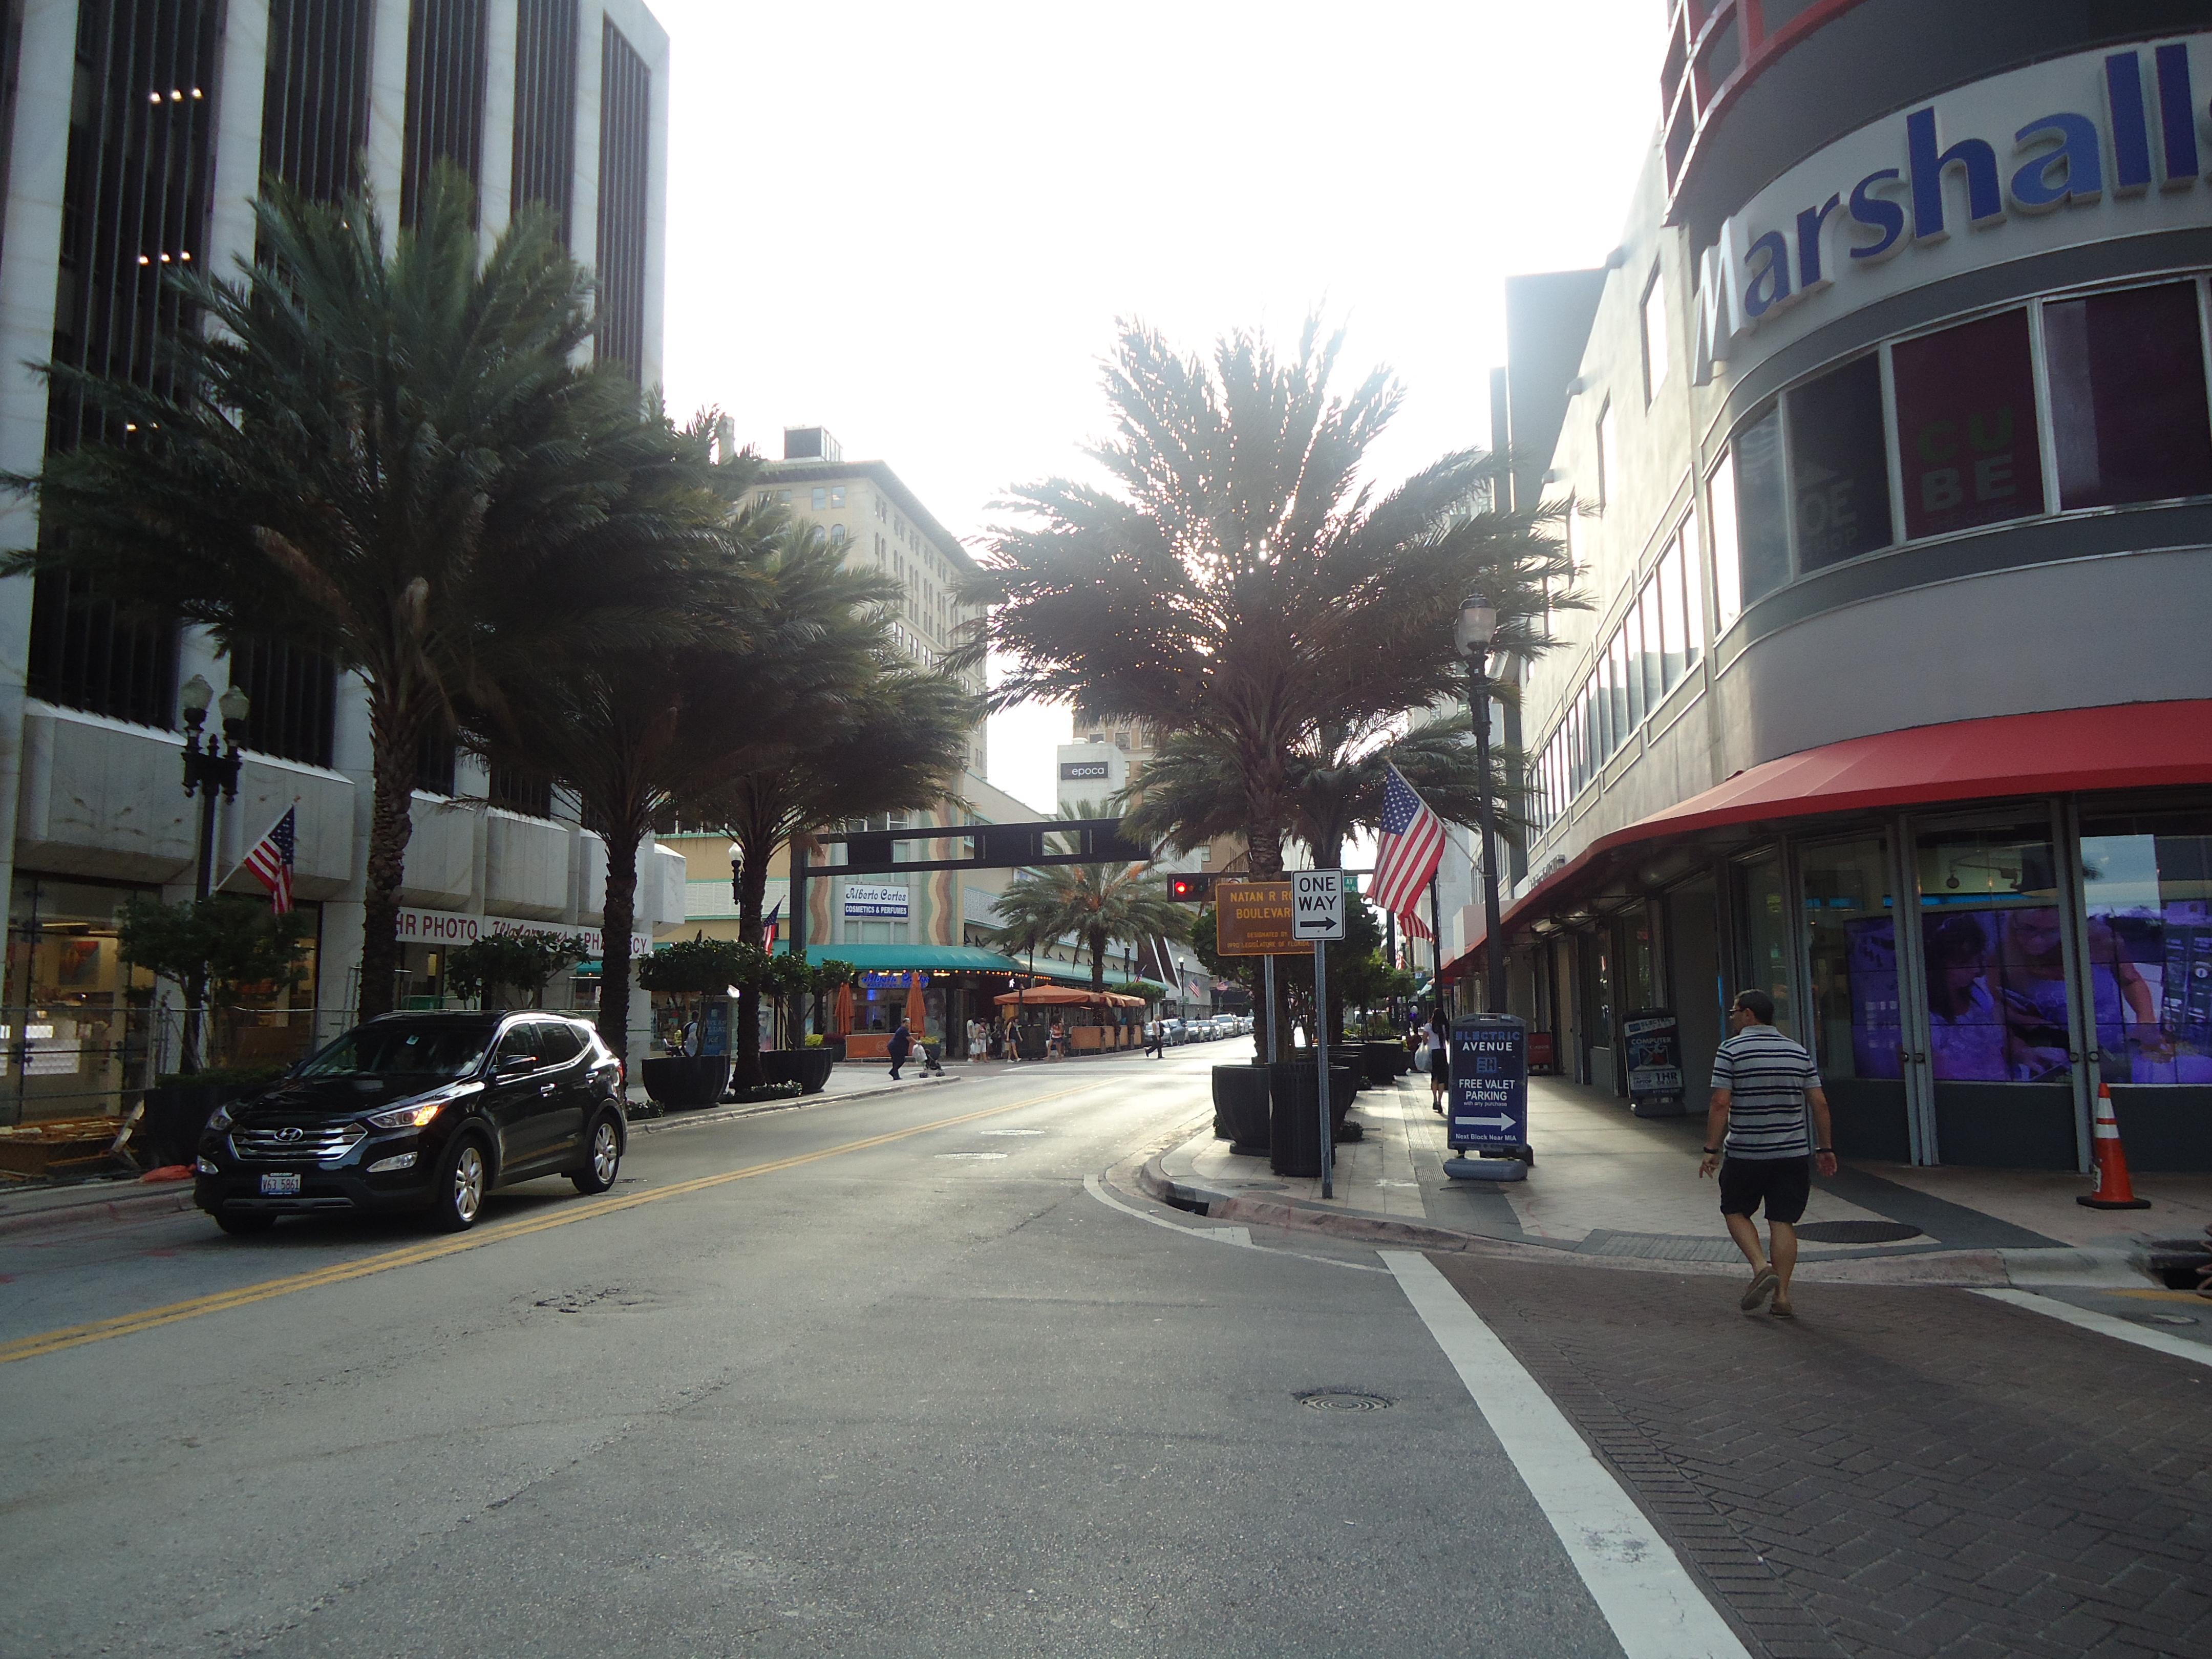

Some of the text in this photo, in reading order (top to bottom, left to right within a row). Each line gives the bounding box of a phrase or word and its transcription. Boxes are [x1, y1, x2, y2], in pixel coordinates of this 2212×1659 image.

[1692, 43, 2212, 386] Marshall
[1072, 768, 1104, 777] epoca
[1299, 876, 1336, 892] ONE
[846, 887, 906, 901] Alberto Cortes
[1230, 891, 1264, 902] NATAN
[1269, 891, 1276, 901] R
[1299, 896, 1337, 911] WAY
[845, 905, 875, 913] COSMETICS
[881, 906, 907, 914] PERFUMES
[1236, 907, 1292, 919] BOULEVAR
[423, 916, 478, 940] PHOTO
[1456, 1031, 1520, 1040] ELECTRIC
[1631, 1036, 1672, 1045] COMPUTER
[1462, 1041, 1513, 1051] AVENUE
[1459, 1079, 1516, 1090] FREE VALET
[1465, 1091, 1507, 1101] PARKING
